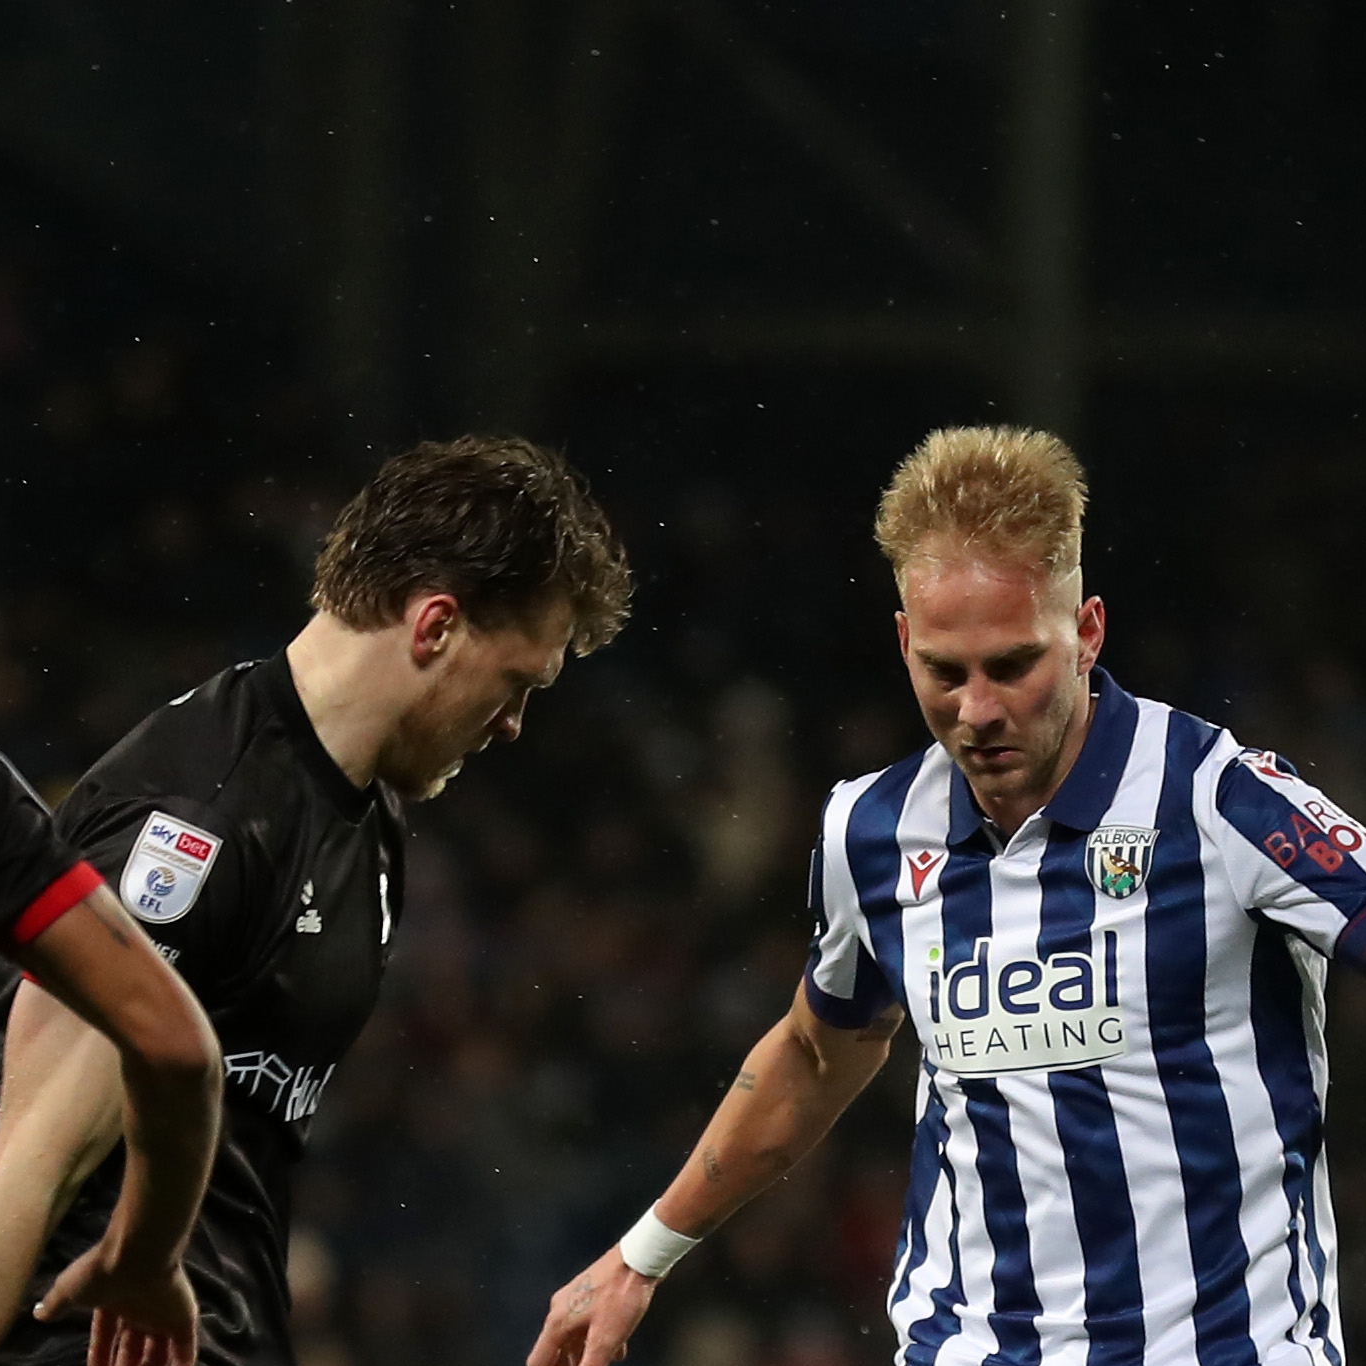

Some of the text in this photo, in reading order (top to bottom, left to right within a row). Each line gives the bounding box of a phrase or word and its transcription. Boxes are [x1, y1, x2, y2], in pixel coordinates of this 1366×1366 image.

[150, 824, 177, 845] sky
[177, 834, 210, 858] bet
[1092, 833, 1152, 845] ALBION
[139, 894, 162, 914] EFL
[929, 930, 1120, 1024] ideal
[934, 1017, 1123, 1061] HEATING
